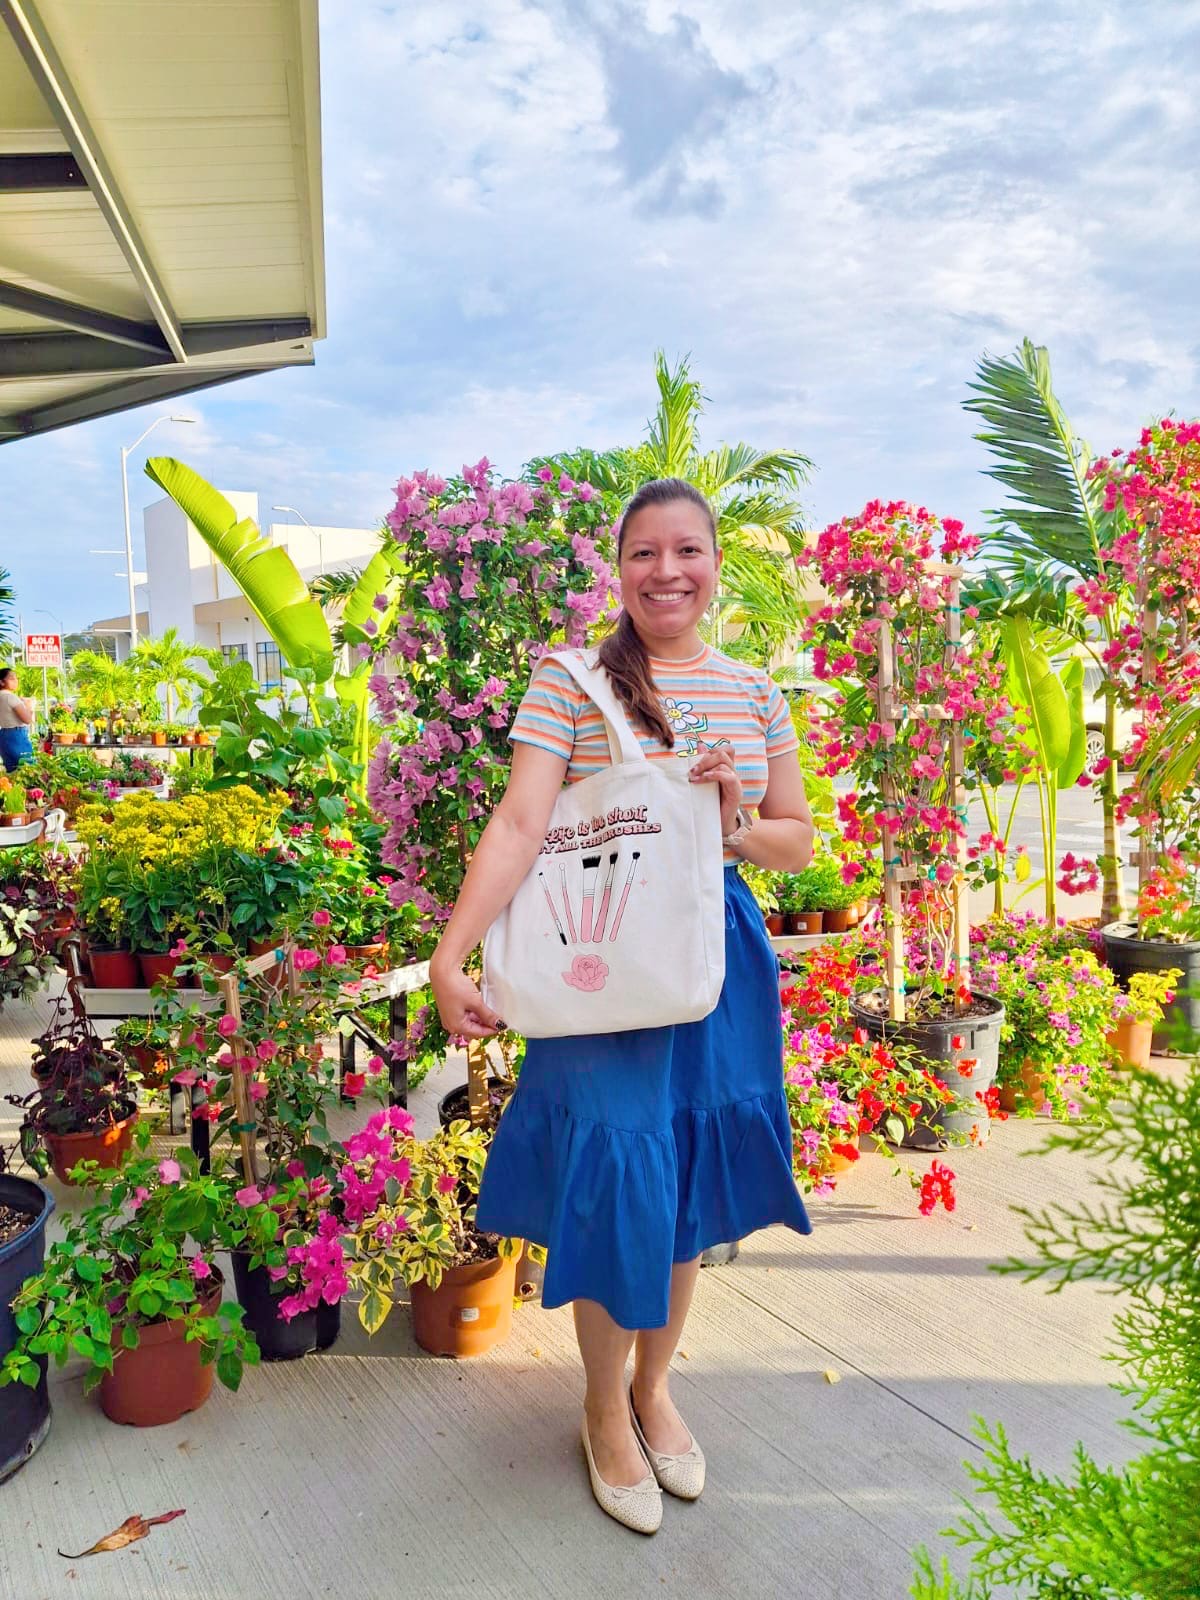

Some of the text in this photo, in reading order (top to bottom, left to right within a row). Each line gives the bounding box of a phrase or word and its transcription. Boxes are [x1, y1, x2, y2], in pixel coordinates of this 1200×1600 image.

[29, 644, 59, 652] SALIDA
[30, 654, 59, 662] NO ENTRE
[545, 826, 575, 844] Life
[578, 820, 590, 836] is
[555, 841, 579, 853] ALL
[580, 837, 602, 849] THE
[603, 823, 661, 842] BRUSHES
